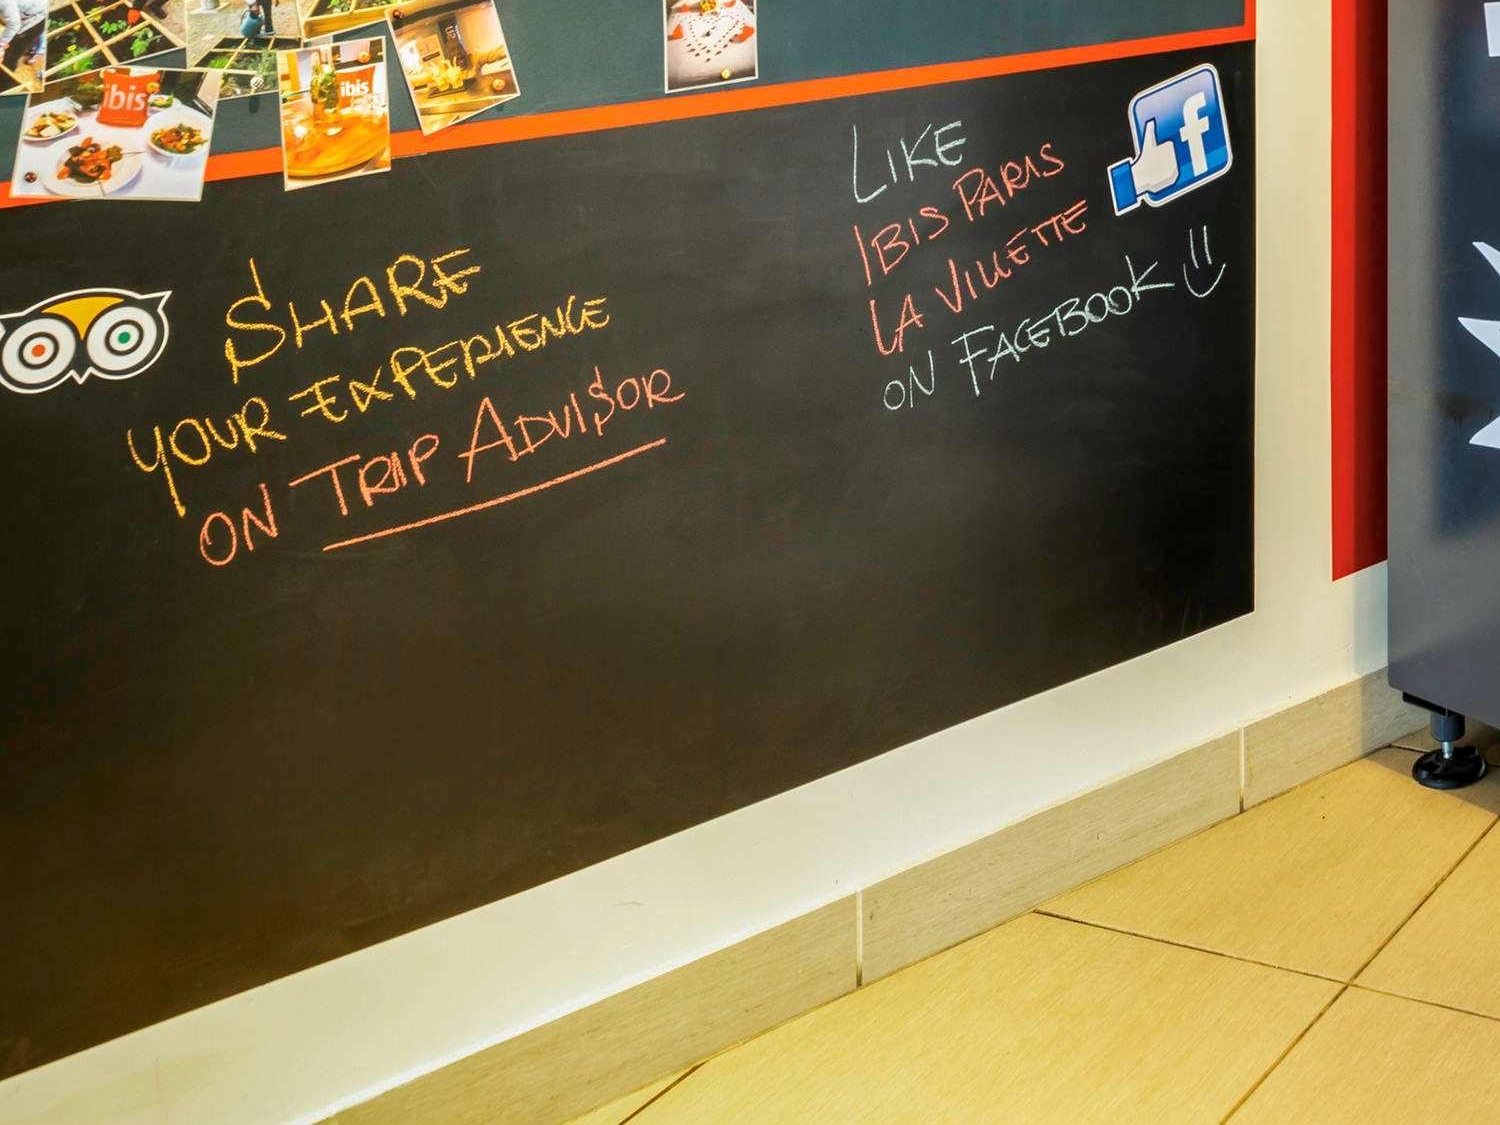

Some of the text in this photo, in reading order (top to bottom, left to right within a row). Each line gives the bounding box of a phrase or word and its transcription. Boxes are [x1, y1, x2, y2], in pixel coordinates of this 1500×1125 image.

[102, 83, 148, 111] ibis
[340, 79, 370, 97] ibis
[852, 120, 967, 203] LIKE
[853, 142, 1066, 286] IBIS PARIS
[223, 248, 481, 384] SHARE
[869, 199, 1089, 356] LA VILLETTE
[950, 255, 1176, 397] FACEBOOK
[199, 483, 279, 567] ON
[288, 433, 440, 516] TRIP
